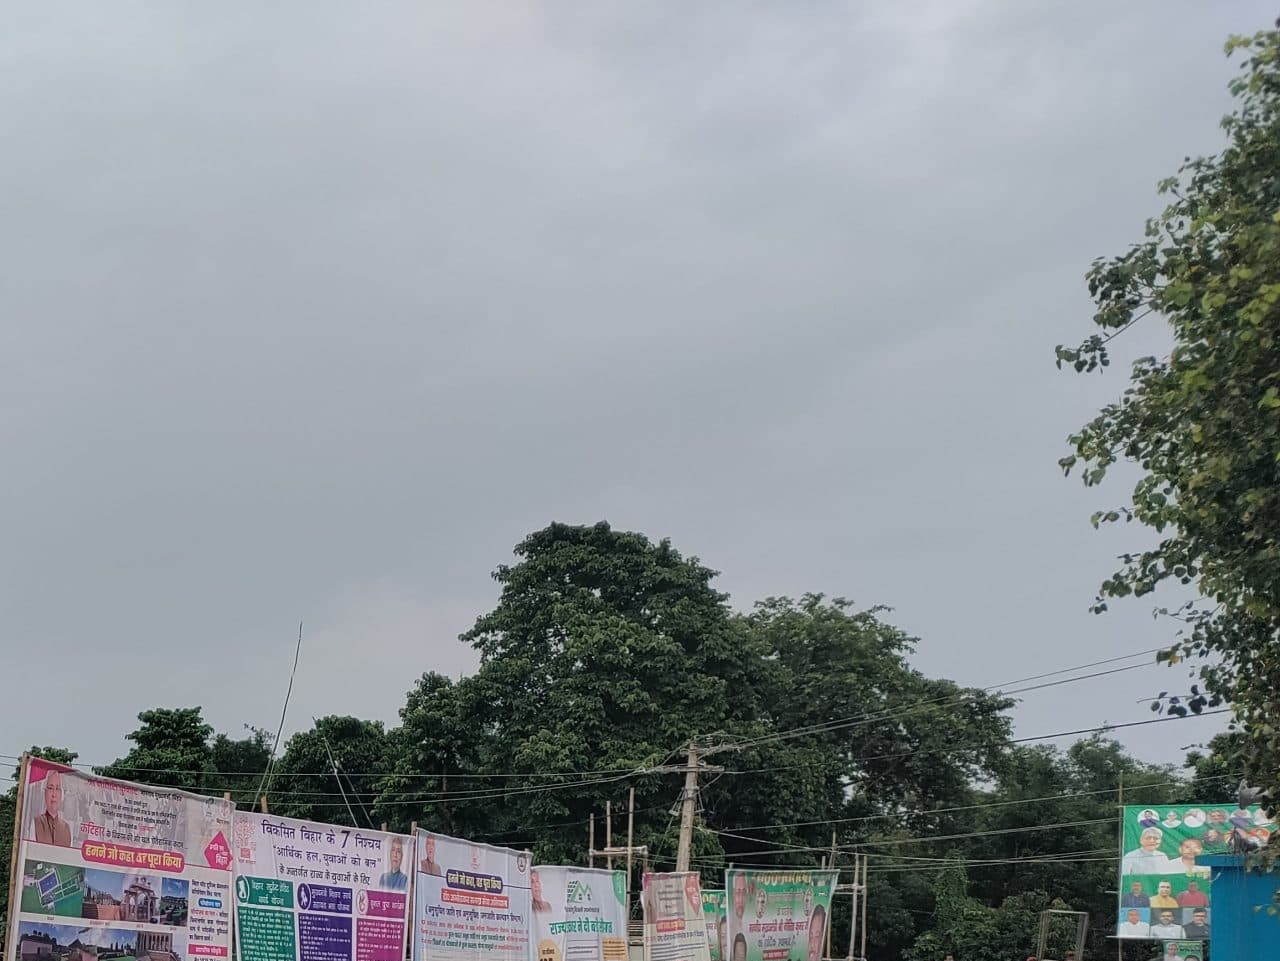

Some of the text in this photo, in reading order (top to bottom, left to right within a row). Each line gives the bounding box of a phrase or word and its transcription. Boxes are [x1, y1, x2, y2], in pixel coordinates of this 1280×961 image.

[261, 819, 295, 840] विकसित
[300, 826, 322, 843] बिहार
[326, 829, 336, 845] के
[341, 830, 351, 848] 7
[85, 843, 182, 868] हमने जो पूरा किया
[351, 854, 361, 866] को
